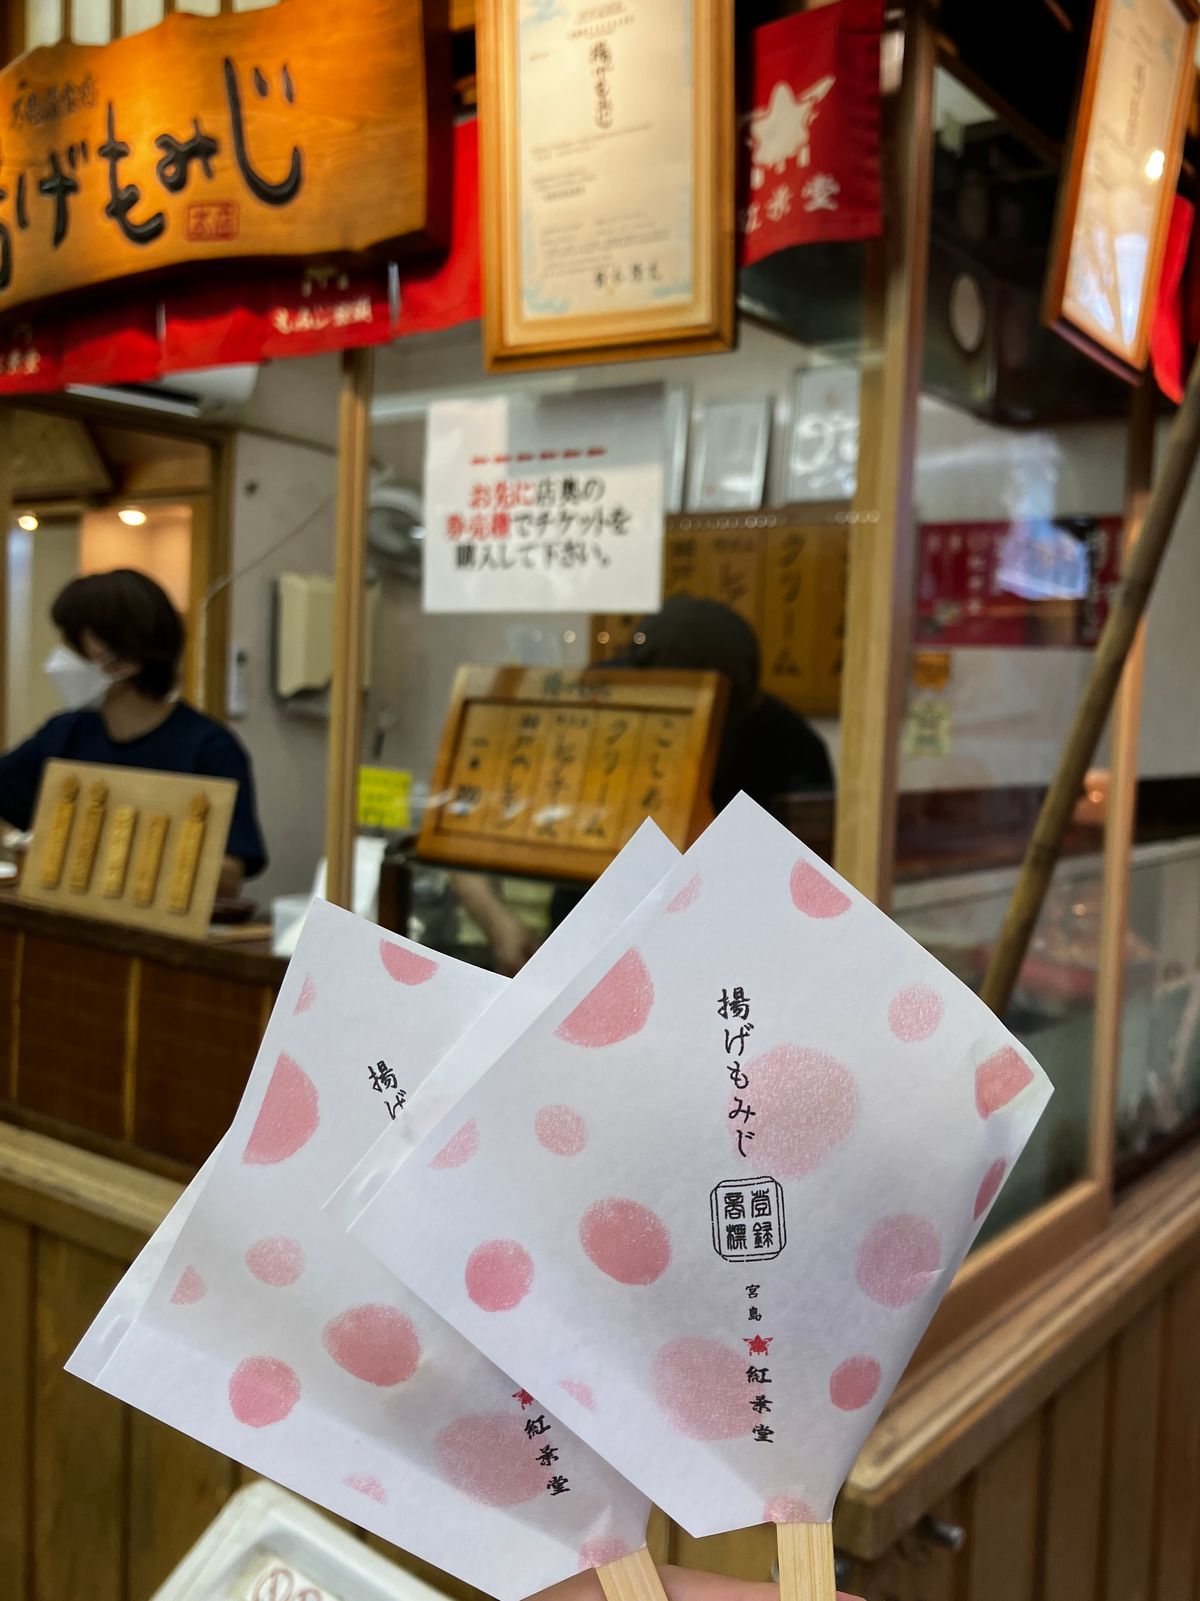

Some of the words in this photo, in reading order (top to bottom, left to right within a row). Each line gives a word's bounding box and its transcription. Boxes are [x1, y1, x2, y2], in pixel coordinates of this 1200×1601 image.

[0, 56, 304, 290] げもみじ
[717, 987, 756, 1157] 揚げもみじ
[745, 1284, 762, 1321] 宮島
